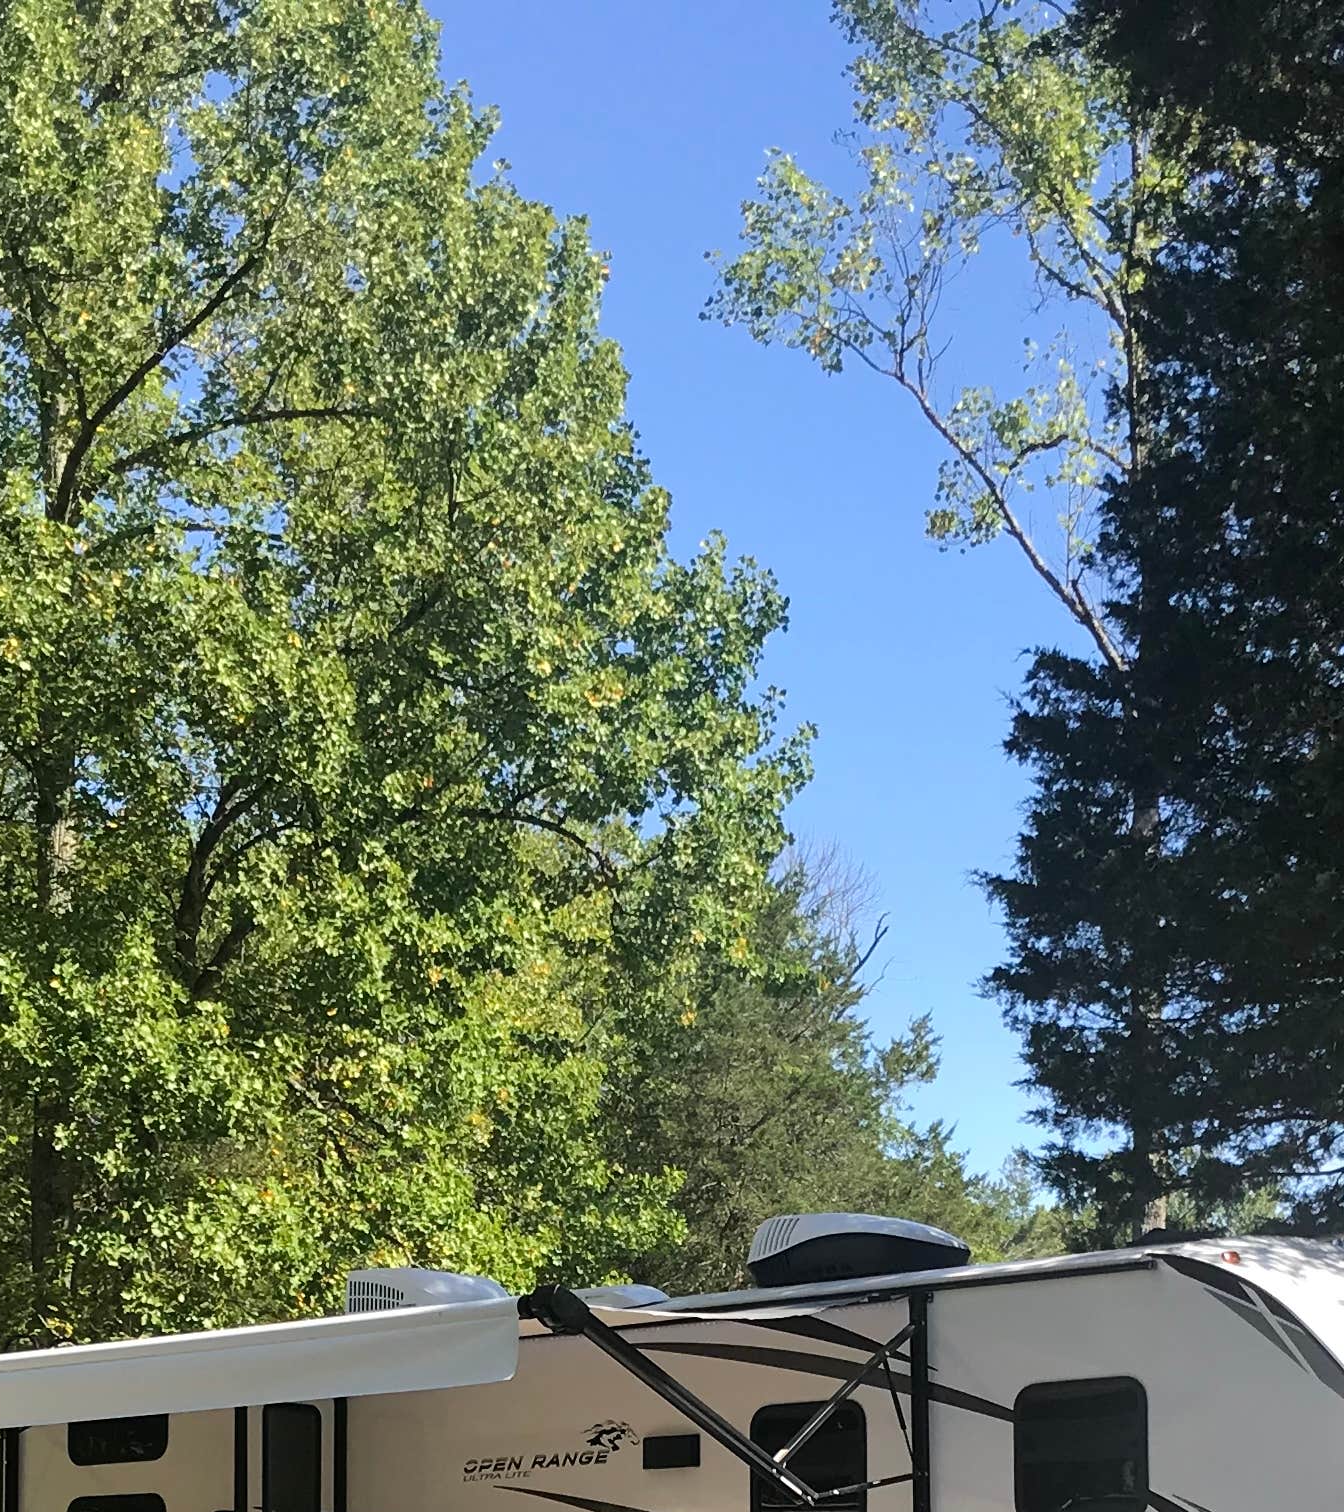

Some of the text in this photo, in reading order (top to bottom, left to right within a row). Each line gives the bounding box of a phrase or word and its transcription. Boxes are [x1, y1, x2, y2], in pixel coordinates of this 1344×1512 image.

[463, 1449, 610, 1473] OPEN RANGE
[463, 1470, 531, 1482] ULTRA LITE
